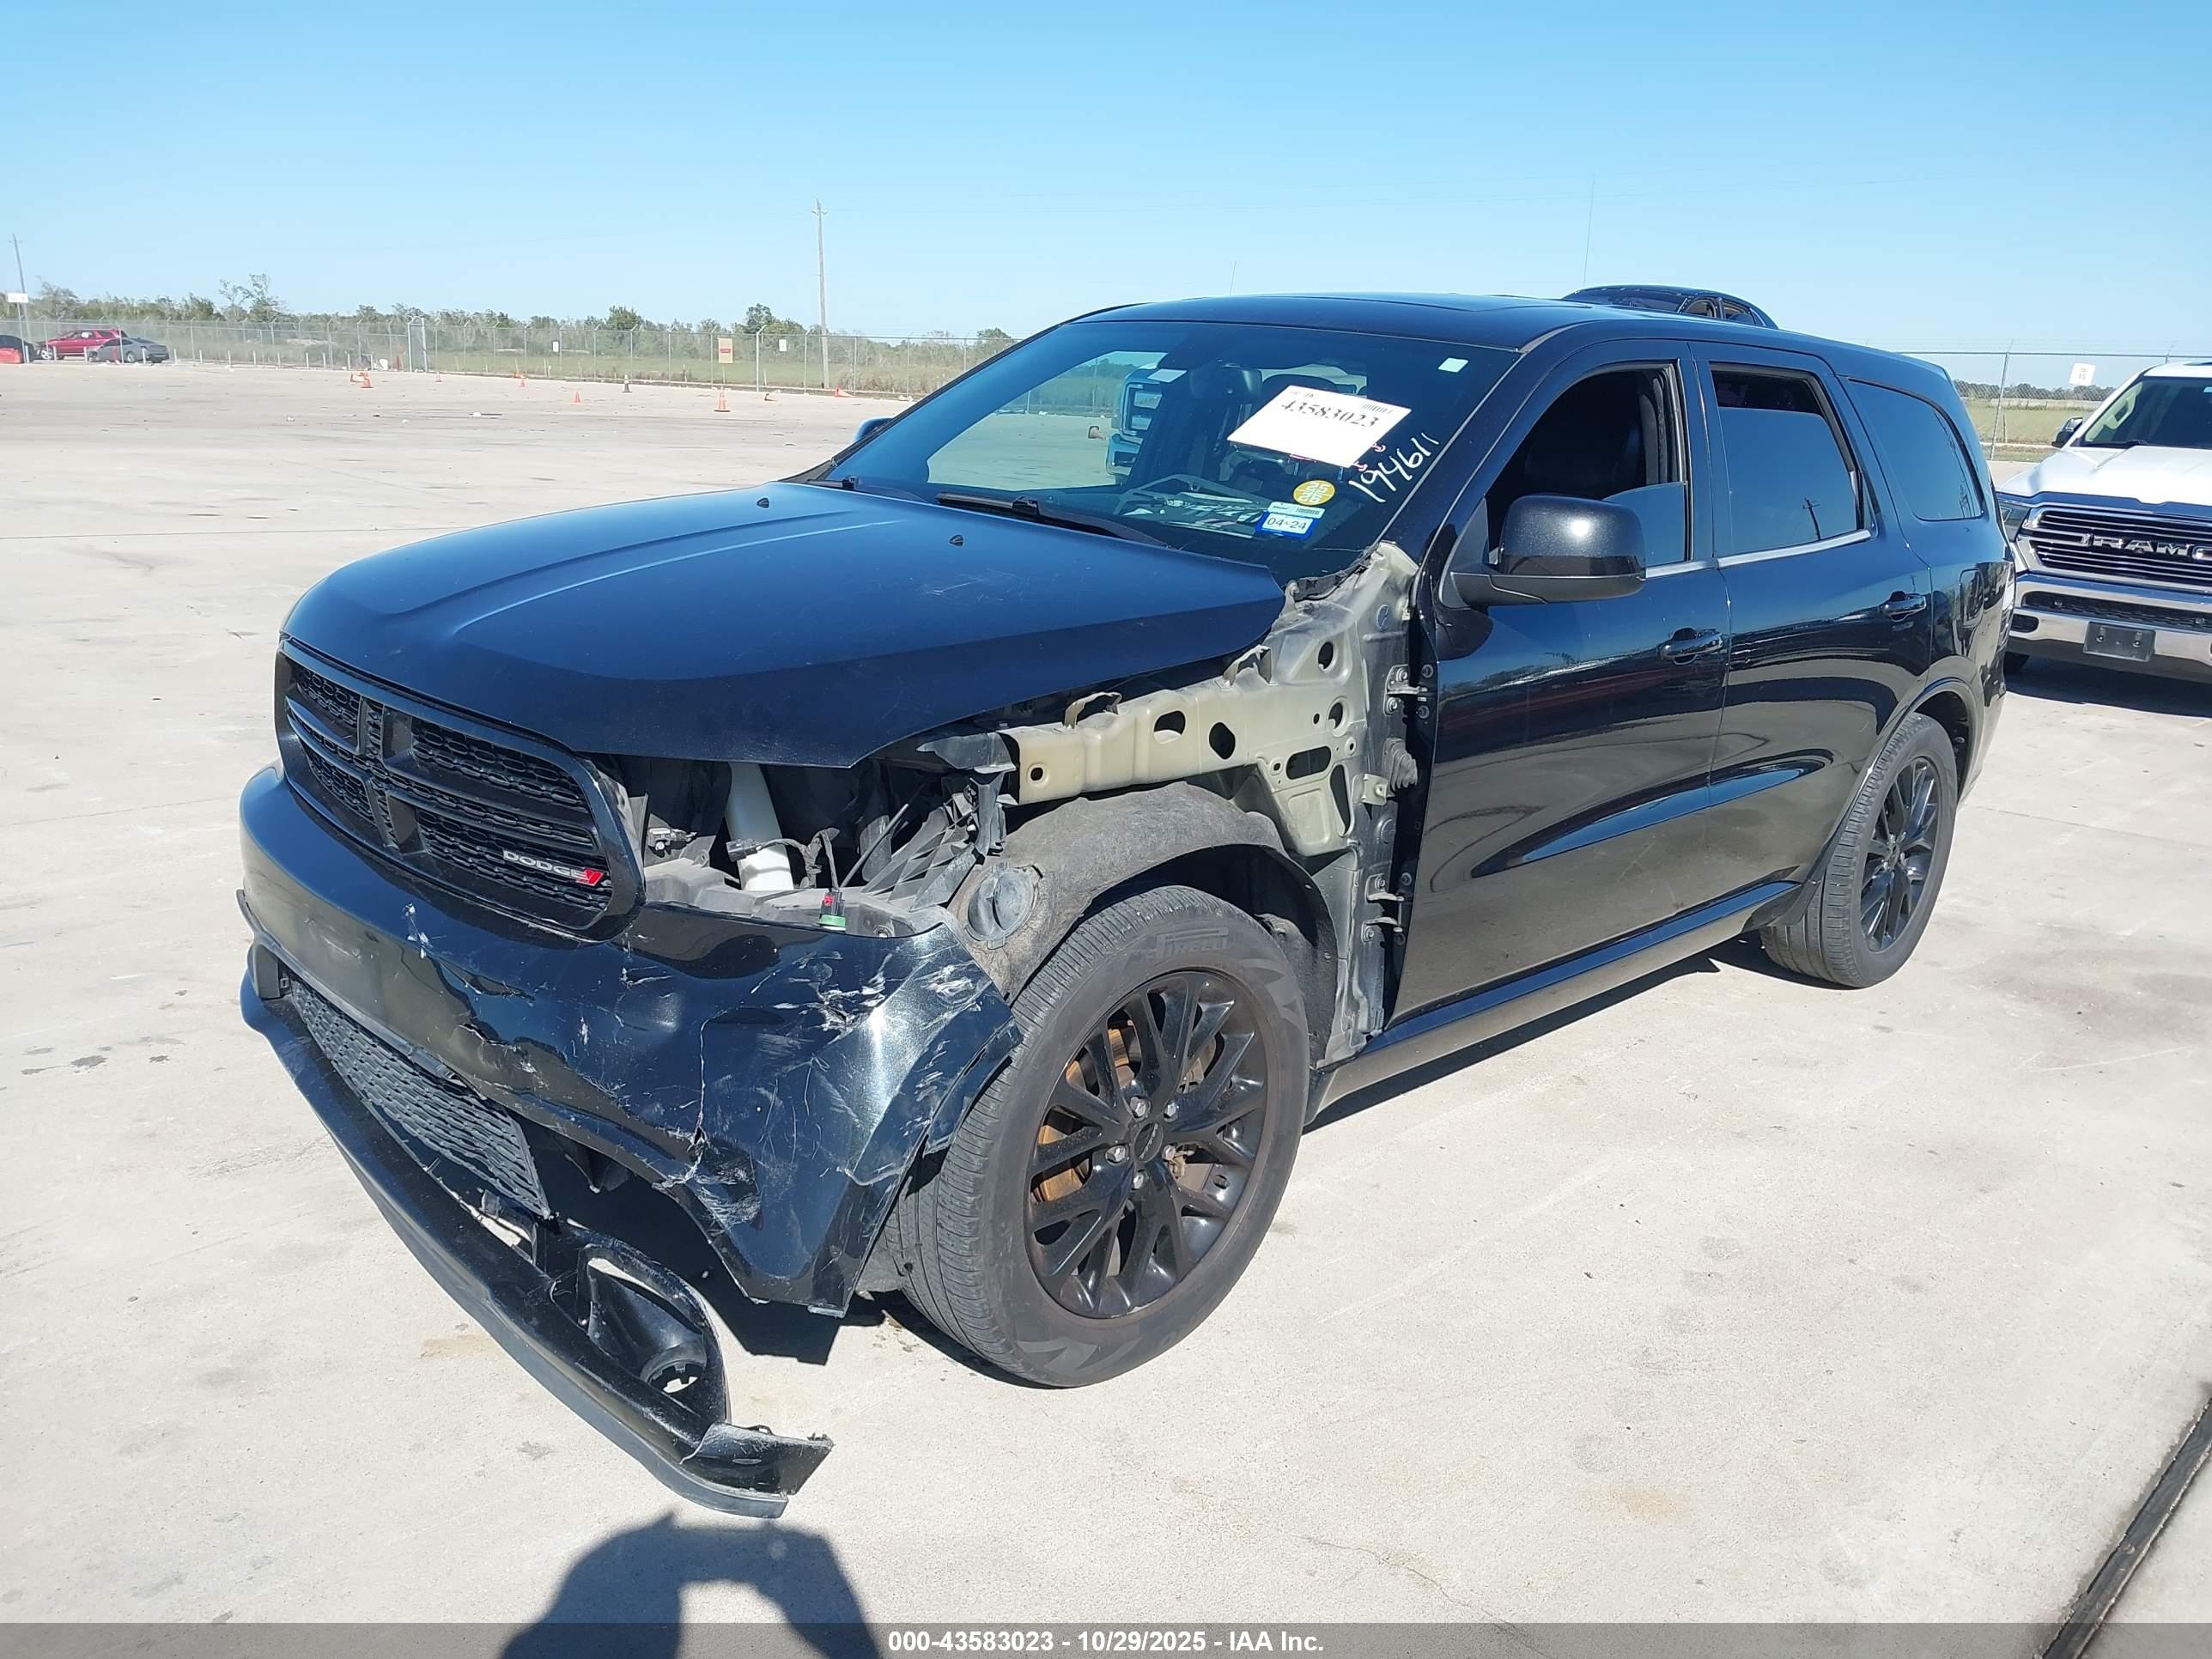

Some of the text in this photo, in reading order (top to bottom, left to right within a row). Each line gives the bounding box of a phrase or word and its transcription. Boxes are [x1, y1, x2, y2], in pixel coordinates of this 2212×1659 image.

[1281, 400, 1379, 427] 43583023
[1305, 482, 1330, 492] 25
[2093, 535, 2190, 556] RAM
[502, 850, 590, 880] DODGE
[1155, 927, 1230, 962] PIRELLI
